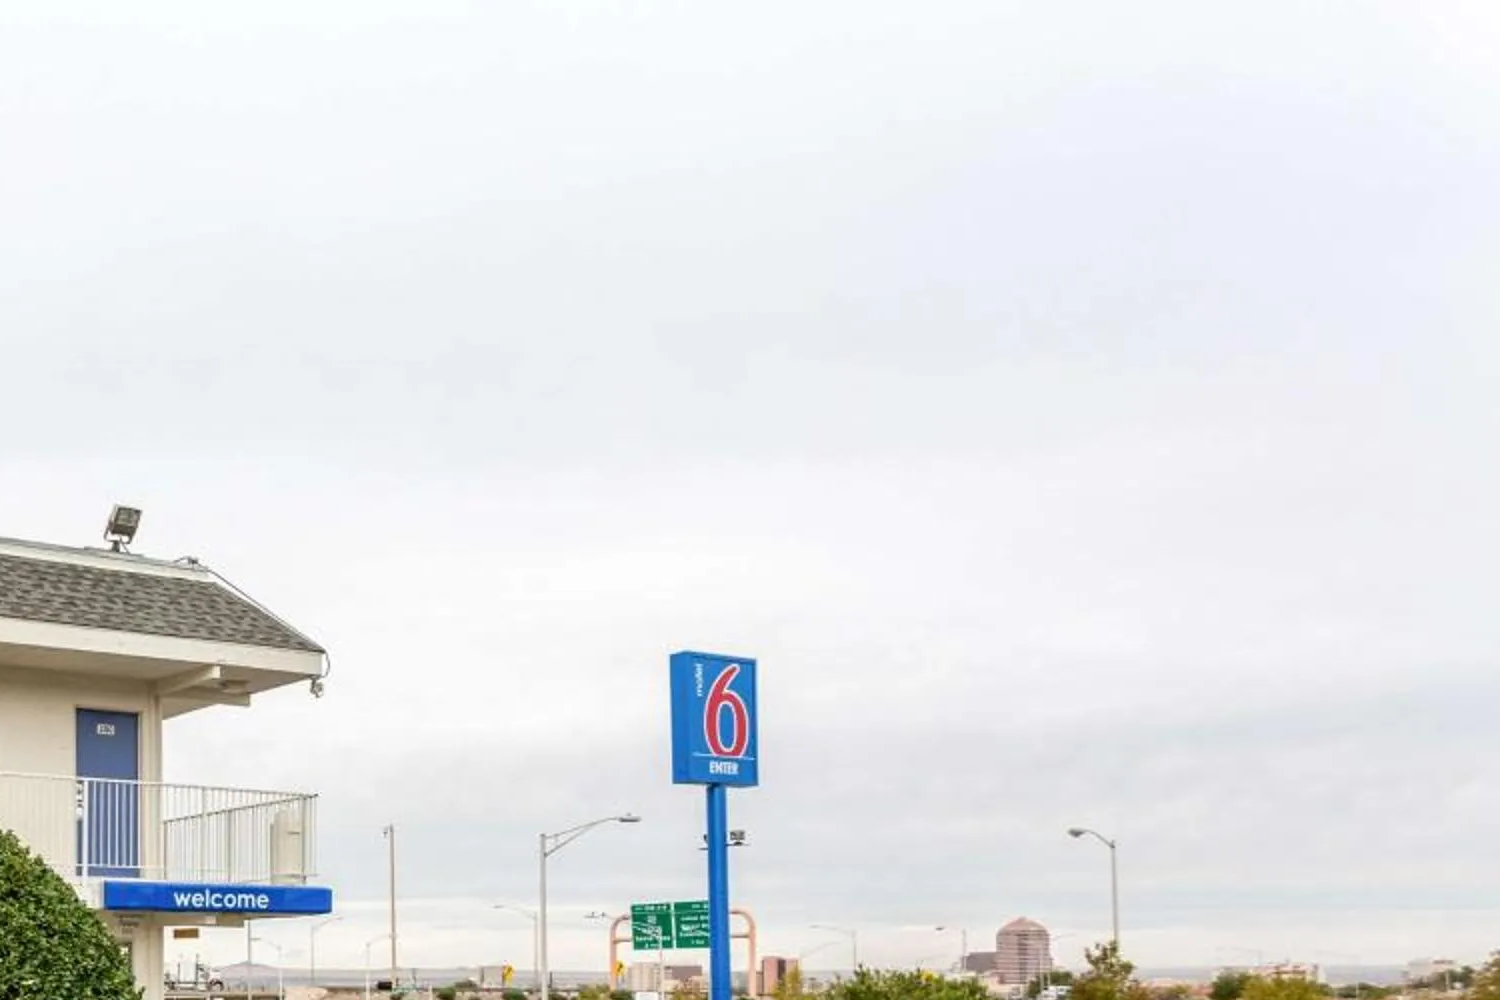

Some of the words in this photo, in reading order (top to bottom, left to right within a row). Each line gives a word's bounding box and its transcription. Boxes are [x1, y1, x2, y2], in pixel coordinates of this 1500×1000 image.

[703, 663, 748, 758] 6
[709, 761, 739, 775] ENTER
[173, 888, 269, 909] welcome
